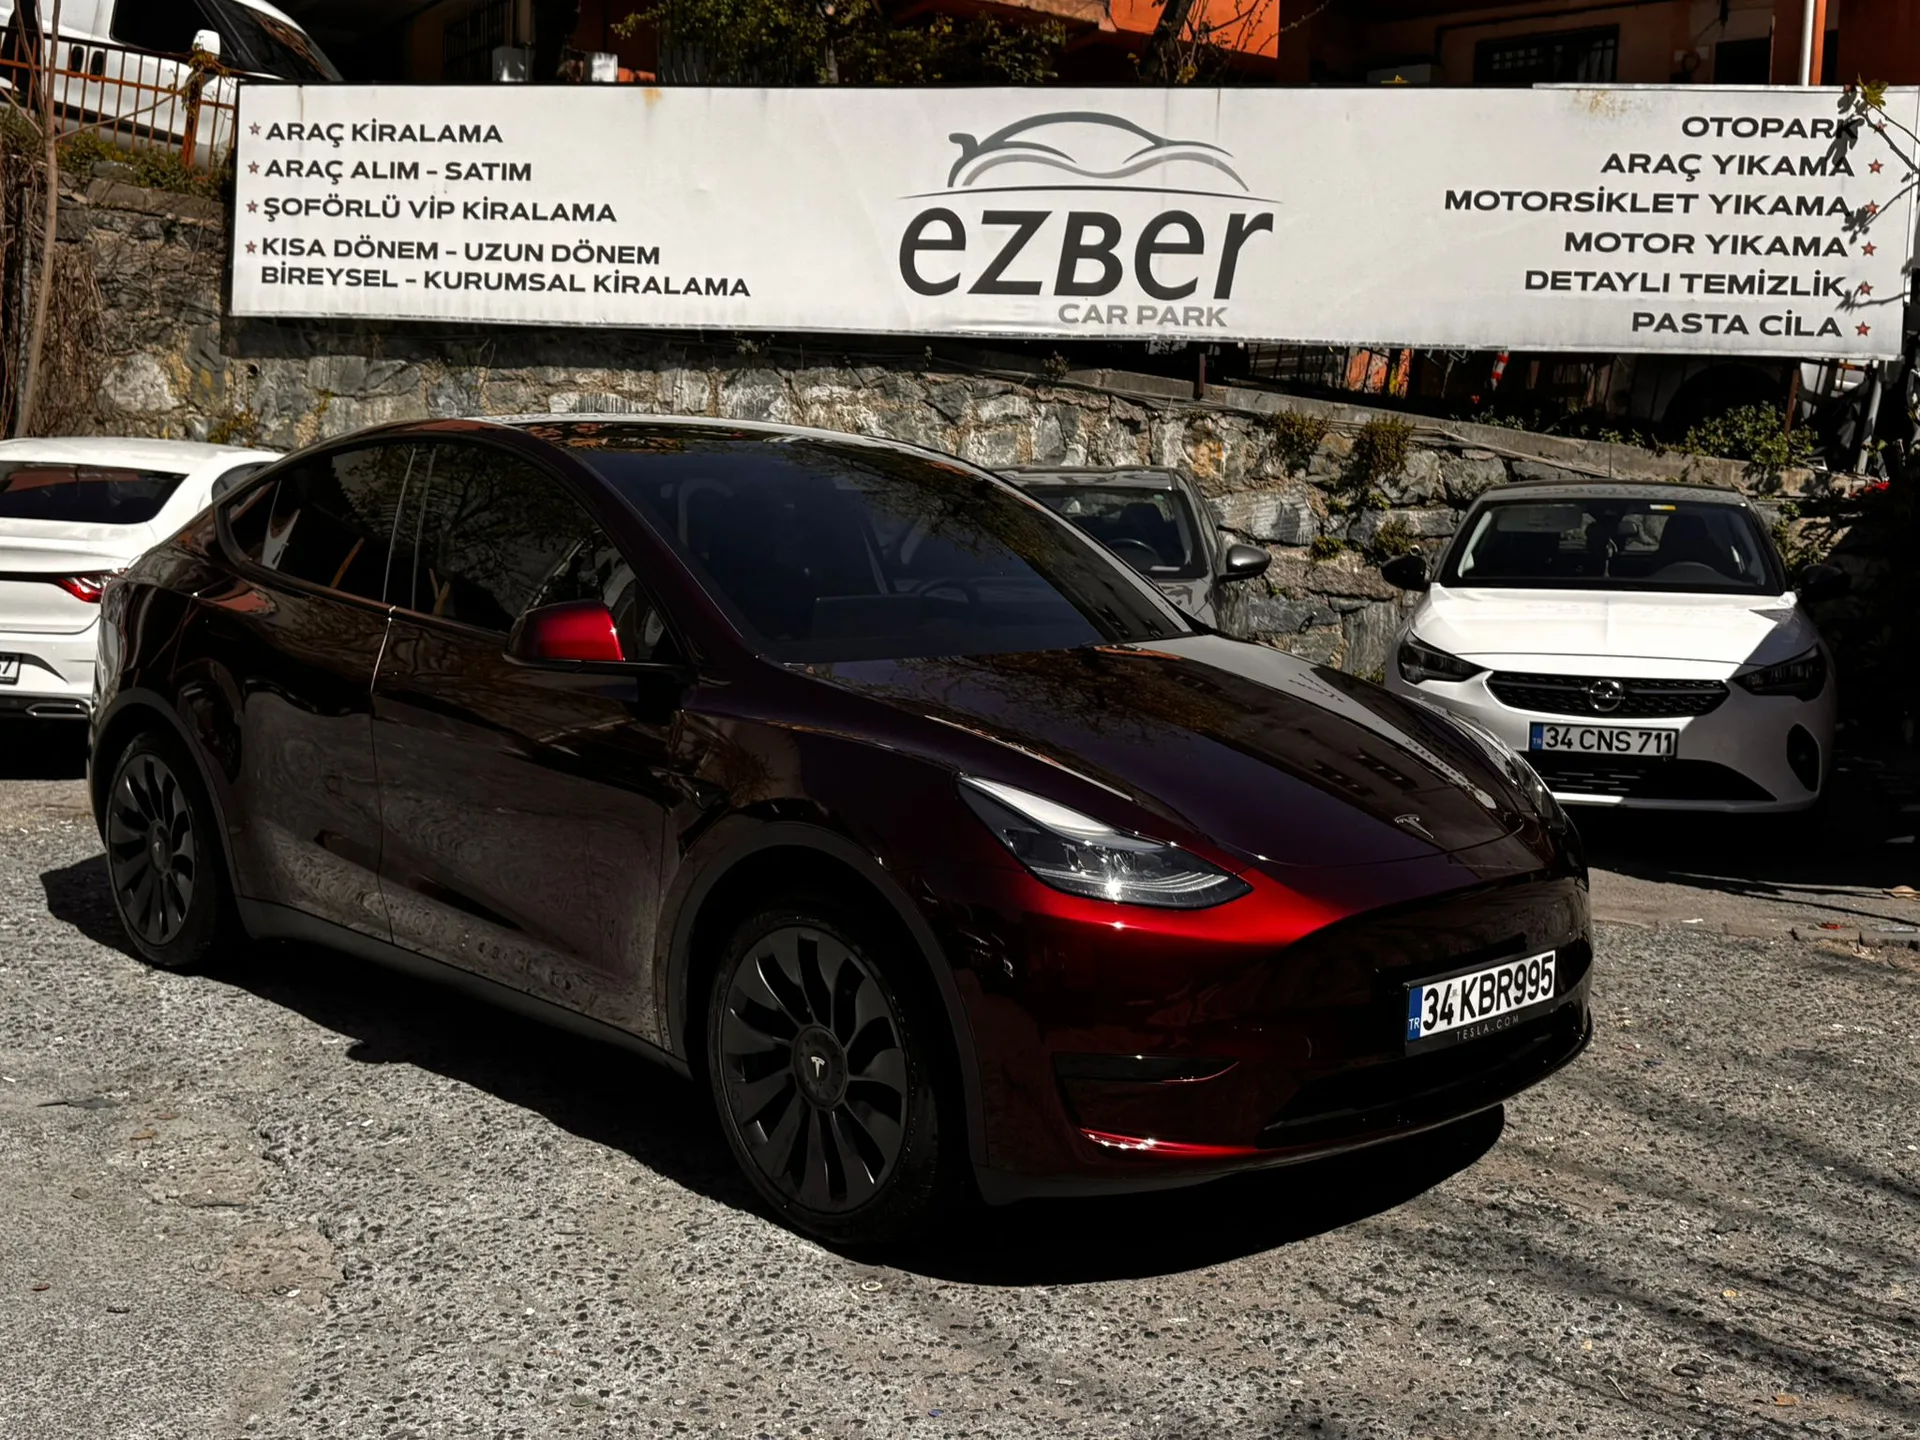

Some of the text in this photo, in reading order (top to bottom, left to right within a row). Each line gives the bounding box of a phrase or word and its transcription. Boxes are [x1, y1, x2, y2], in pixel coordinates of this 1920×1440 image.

[266, 118, 503, 148] ARAÇ KİRALAMA
[1681, 117, 1858, 139] OTOPARK
[264, 159, 343, 185] ARAÇ
[350, 161, 419, 180] ALIM
[445, 162, 531, 181] SATIM
[1600, 153, 1856, 182] ARAÇ YIKAMA
[263, 193, 617, 222] ŞOFÖRLÜ VİP KİRALAMA
[1444, 185, 1851, 217] MOTORSİKLET YIKAMA
[262, 237, 326, 257] KISA
[334, 234, 438, 260] DÖNEM
[464, 242, 544, 262] UZUN
[551, 239, 660, 265] DÖNEM
[1564, 232, 1849, 257] MOTOR YIKAMA
[261, 264, 398, 287] BİREYSEL
[424, 271, 586, 292] KURUMSAL
[593, 274, 751, 297] KİRALAMA
[1525, 269, 1846, 297] DETAYLI TEMİZLİK
[1058, 304, 1227, 328] CAR PARK
[1632, 309, 1843, 337] PASTA CİLA
[1545, 726, 1673, 755] 34 CNS 711
[1408, 1016, 1420, 1031] TR
[1456, 1015, 1519, 1041] TESLA.COM
